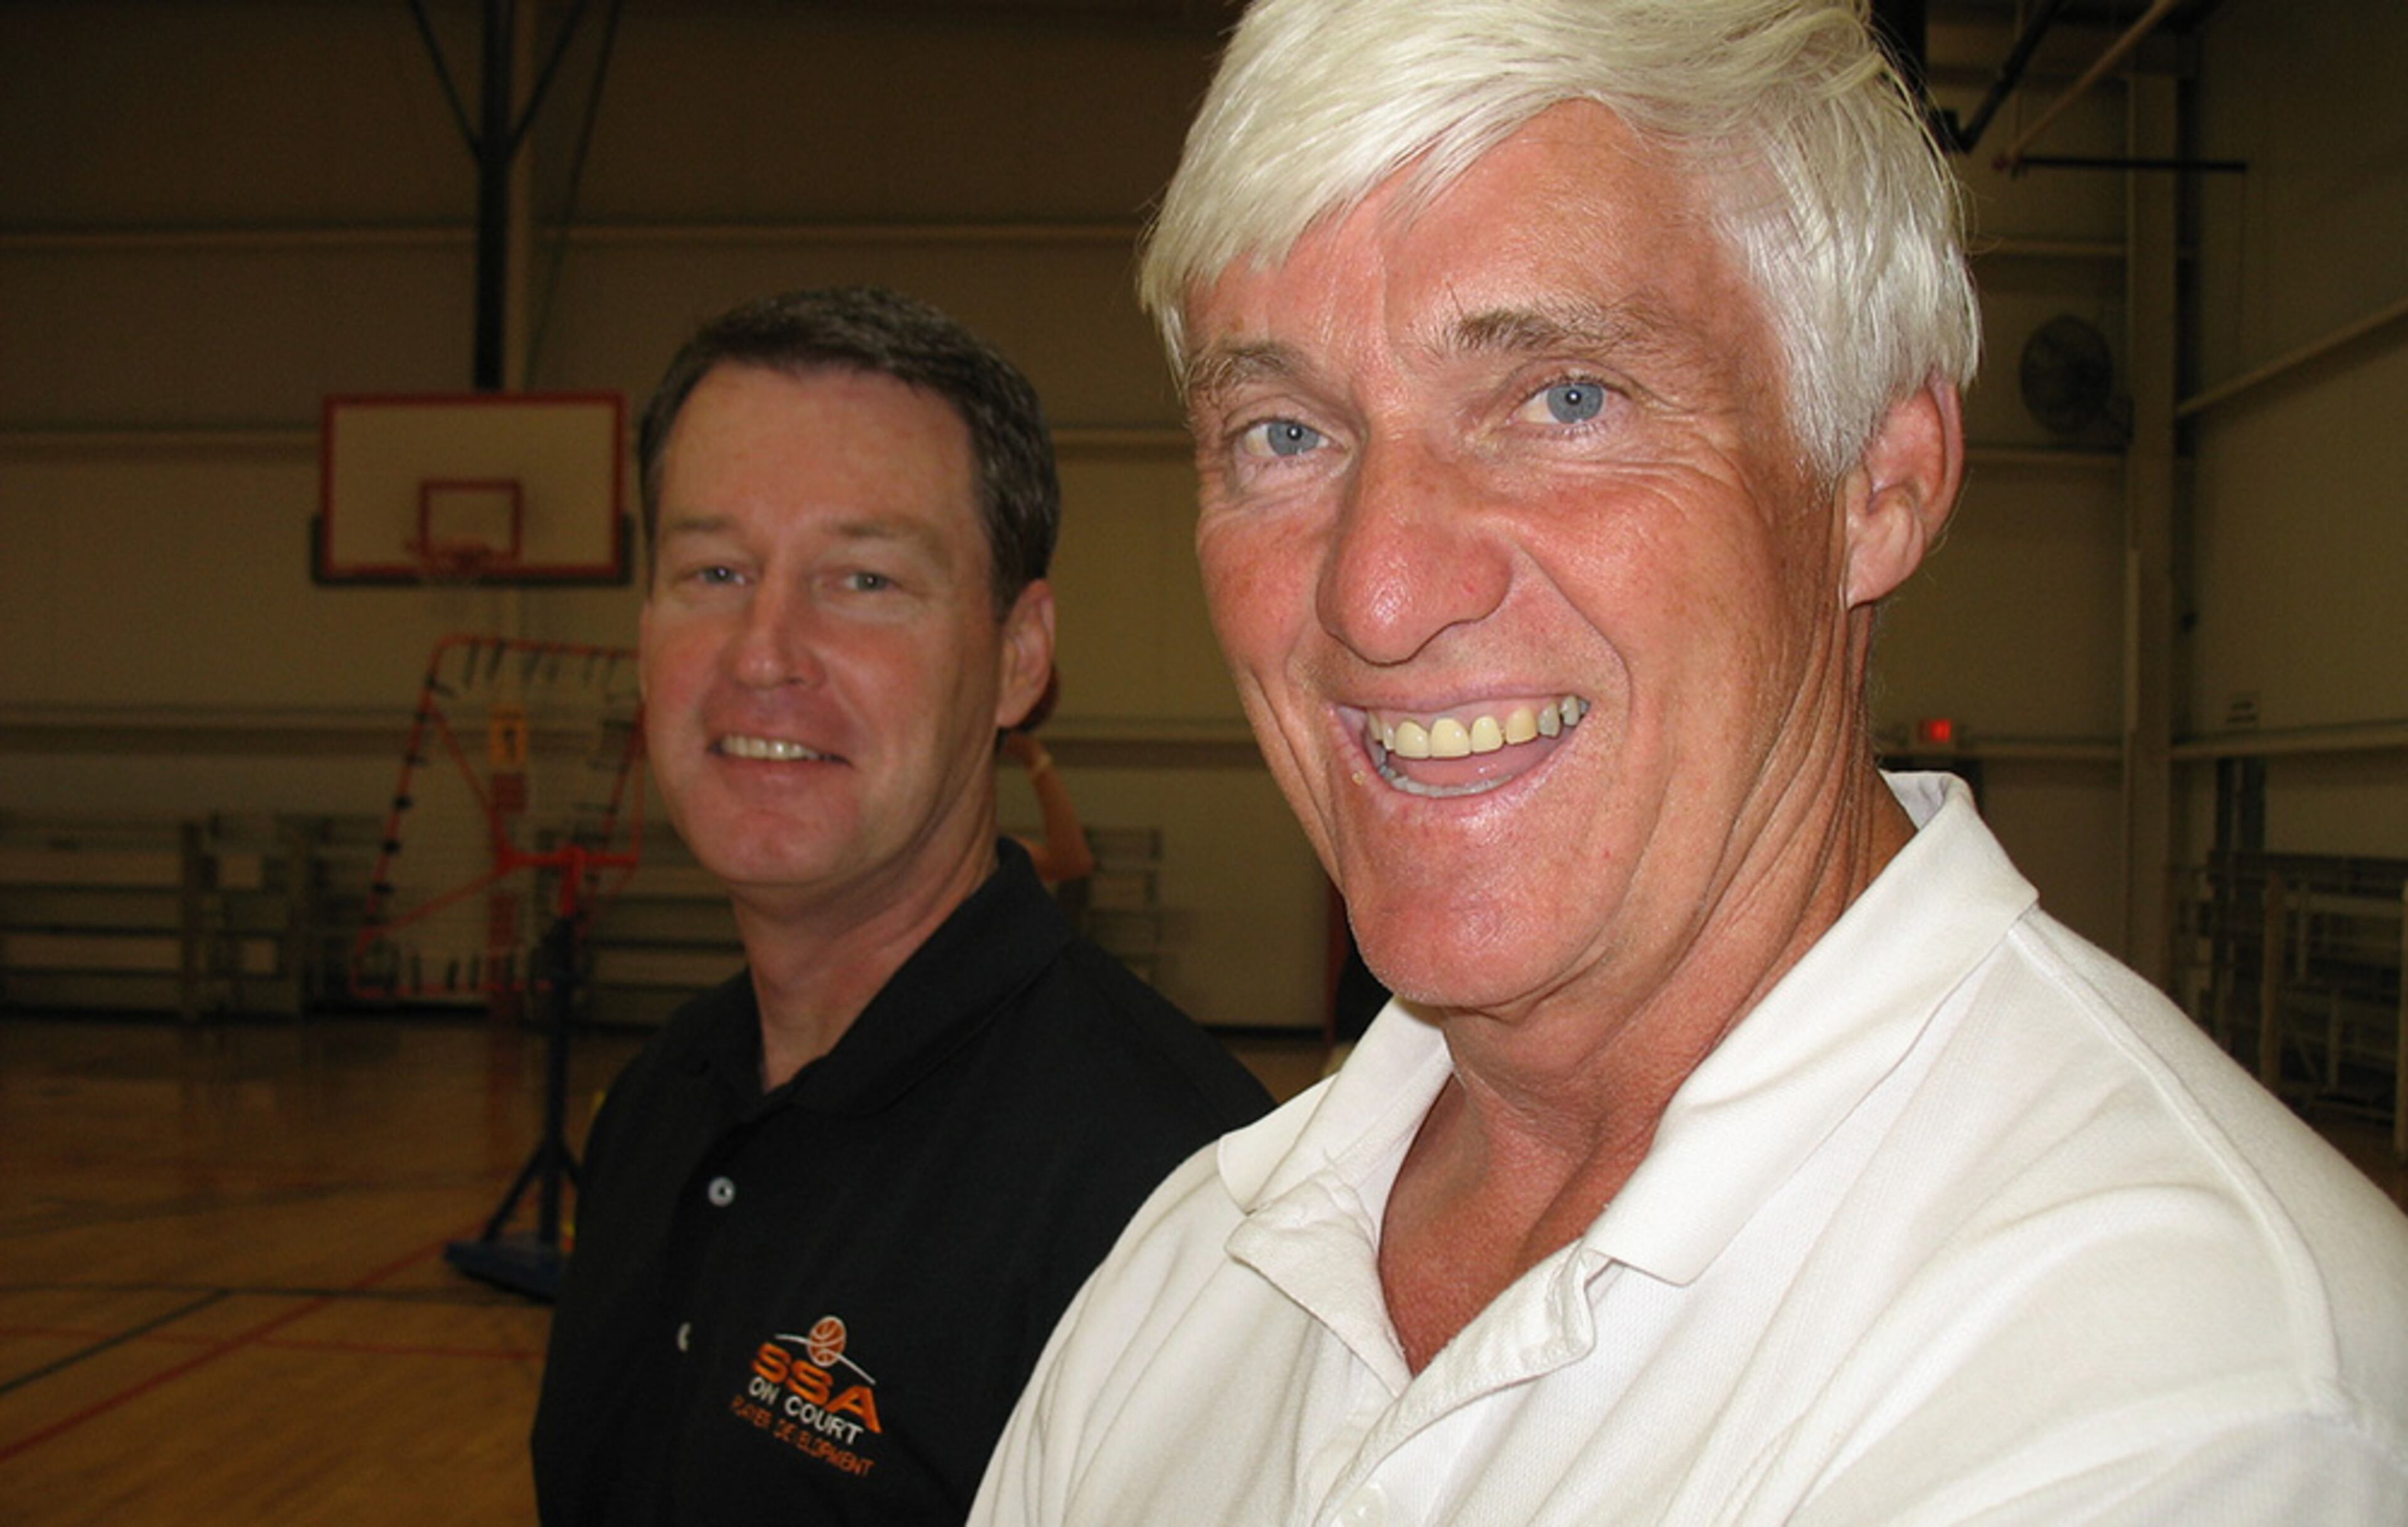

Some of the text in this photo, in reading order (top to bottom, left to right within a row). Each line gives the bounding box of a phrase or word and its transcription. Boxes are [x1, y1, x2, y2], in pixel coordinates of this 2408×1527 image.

[748, 1376, 864, 1445] ON COURT
[752, 1342, 882, 1434] SSA
[773, 1419, 875, 1477] DEELOPMENT
